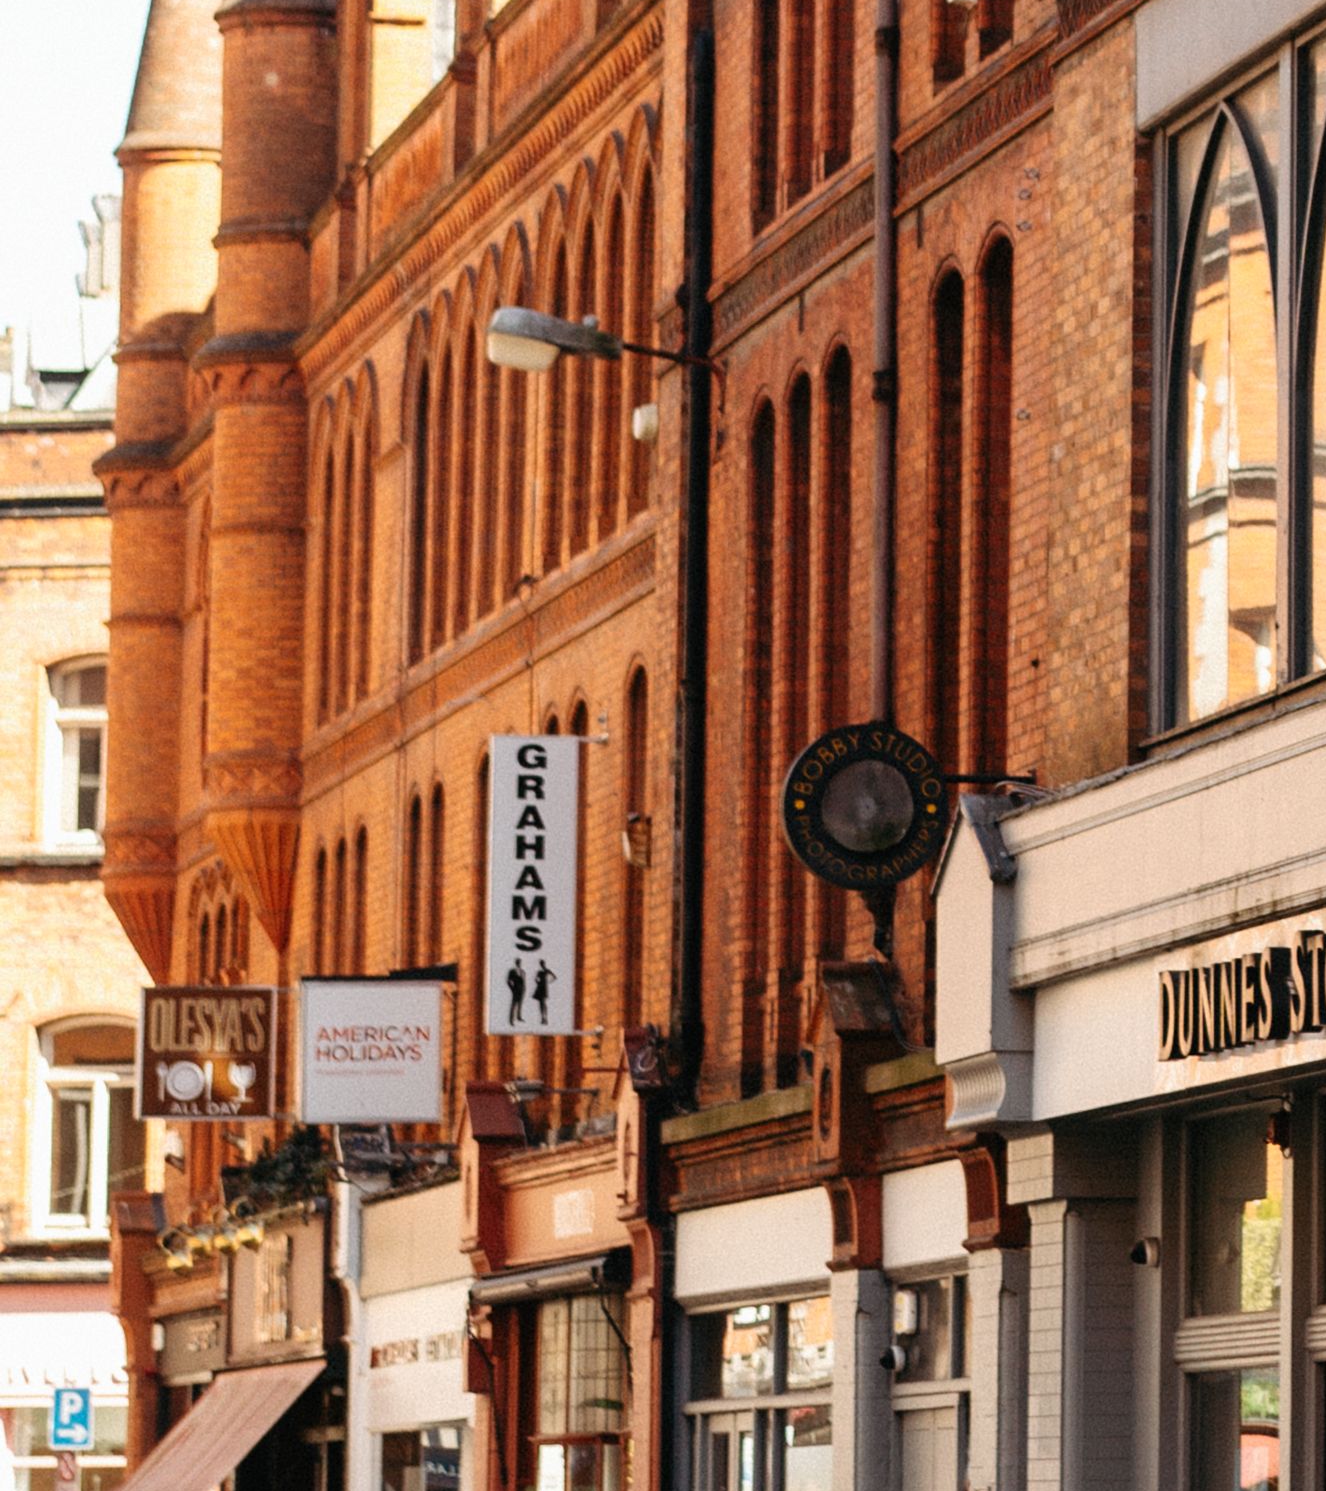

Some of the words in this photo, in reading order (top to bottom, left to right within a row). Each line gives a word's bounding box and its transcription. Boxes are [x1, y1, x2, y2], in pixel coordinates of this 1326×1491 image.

[793, 732, 861, 796] BOBBY
[870, 731, 942, 799] STUDIO
[511, 744, 548, 952] GRAHAMS
[151, 997, 266, 1053] OLESYA'S
[1158, 946, 1289, 1062] DUNNES
[316, 1025, 431, 1043] AMERICAN
[316, 1042, 423, 1062] HOLIDAYS
[170, 1102, 201, 1116] ALL
[206, 1102, 242, 1116] DAY
